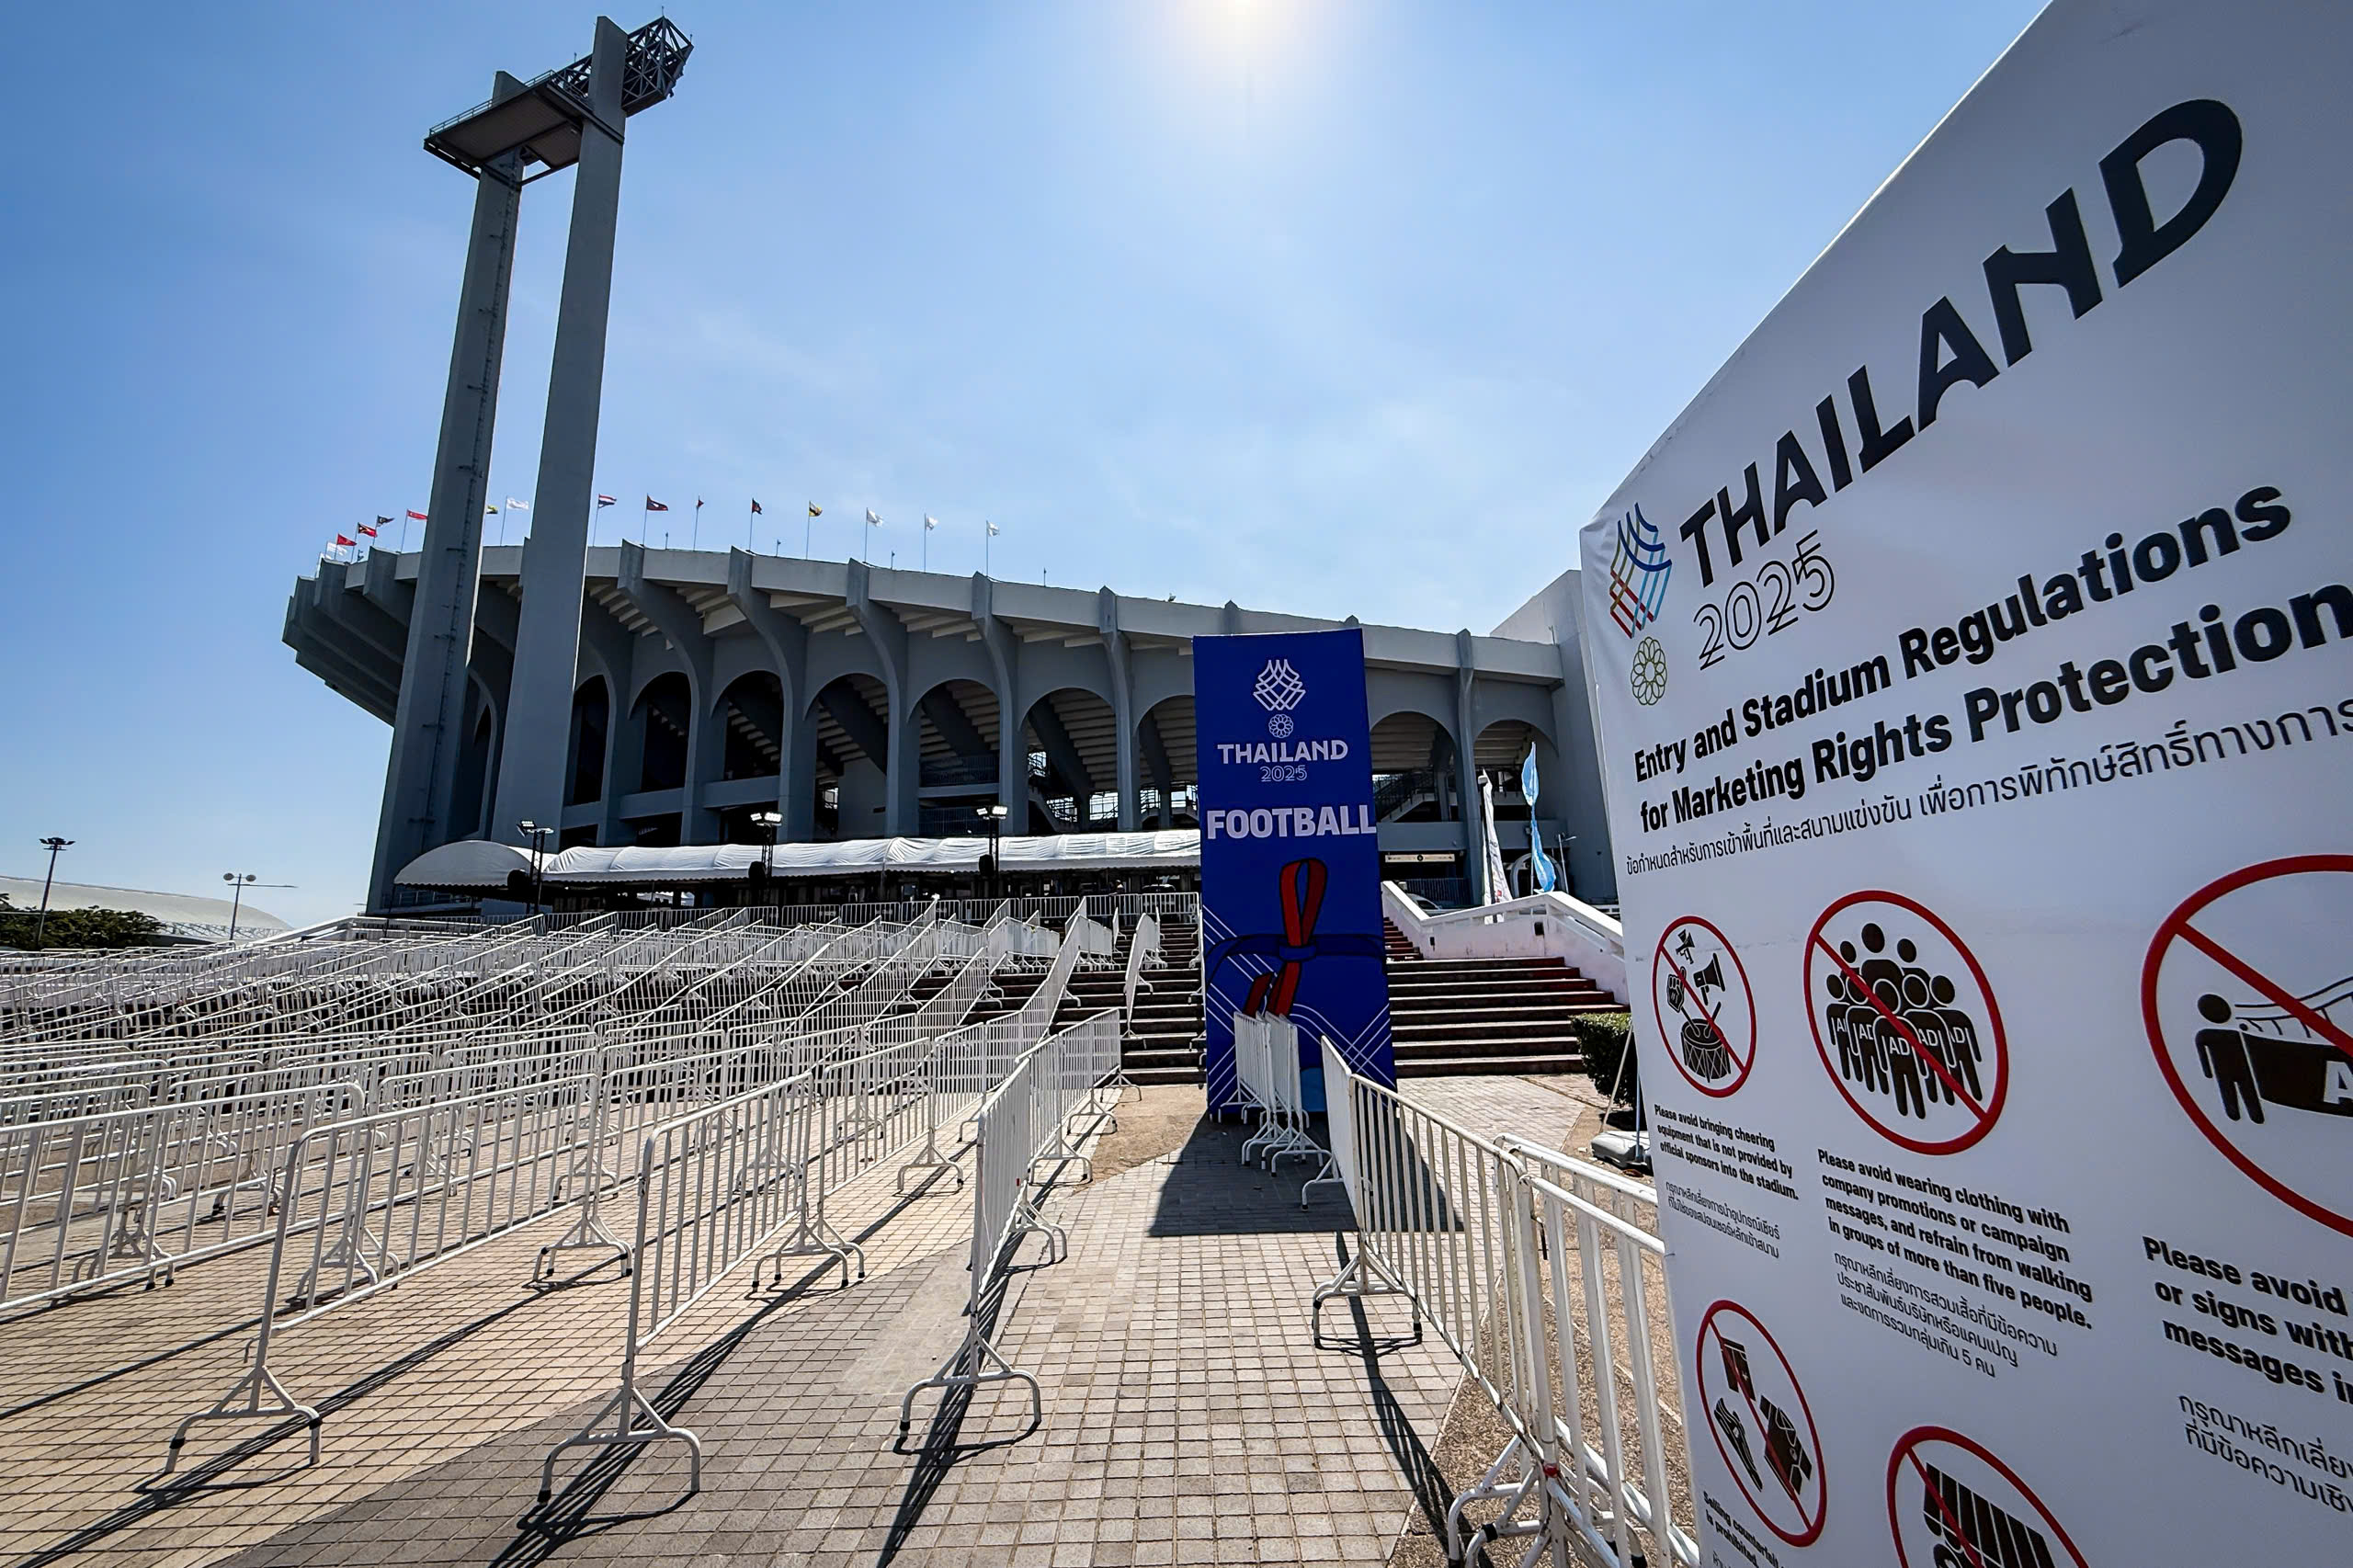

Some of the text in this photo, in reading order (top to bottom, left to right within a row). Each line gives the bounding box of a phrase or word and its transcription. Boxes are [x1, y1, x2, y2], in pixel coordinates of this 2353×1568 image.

[1680, 98, 2243, 588] THAILAND
[1634, 485, 2292, 782] Entry and Stadium Regulations
[1693, 530, 1835, 670] 2025
[1641, 584, 2353, 834] for Marketing Rights Protection
[1217, 740, 1348, 764] THAILAND
[1260, 765, 1307, 781] 2025
[1207, 805, 1377, 839] FOOTBALL
[1626, 794, 1911, 876] ข้อกำหนดสำหรับการเข้าพื้นที่และสนามแข่งขัน
[1889, 1037, 1911, 1056] AD
[1654, 1104, 1775, 1153] Please avoid bringing cheering
[1657, 1124, 1792, 1179] equipment that is not provided by
[1660, 1142, 1799, 1200] official sponsors into the stadium.
[1818, 1149, 2070, 1233] Please avoid wearing clothing with
[1822, 1173, 2069, 1262] company promotions or campaign
[1825, 1197, 2093, 1302] messages, and refrain from walking
[1828, 1216, 2092, 1329] in groups of more than five people.
[2142, 1235, 2347, 1316] Please avoid
[2154, 1282, 2353, 1360] or signs with
[2162, 1320, 2325, 1393] messages
[1962, 1348, 1972, 1366] 5
[1976, 1358, 1995, 1378] คน
[2179, 1395, 2353, 1479] กรุณาหลีกเลี่ย
[1703, 1491, 1731, 1527] Selling
